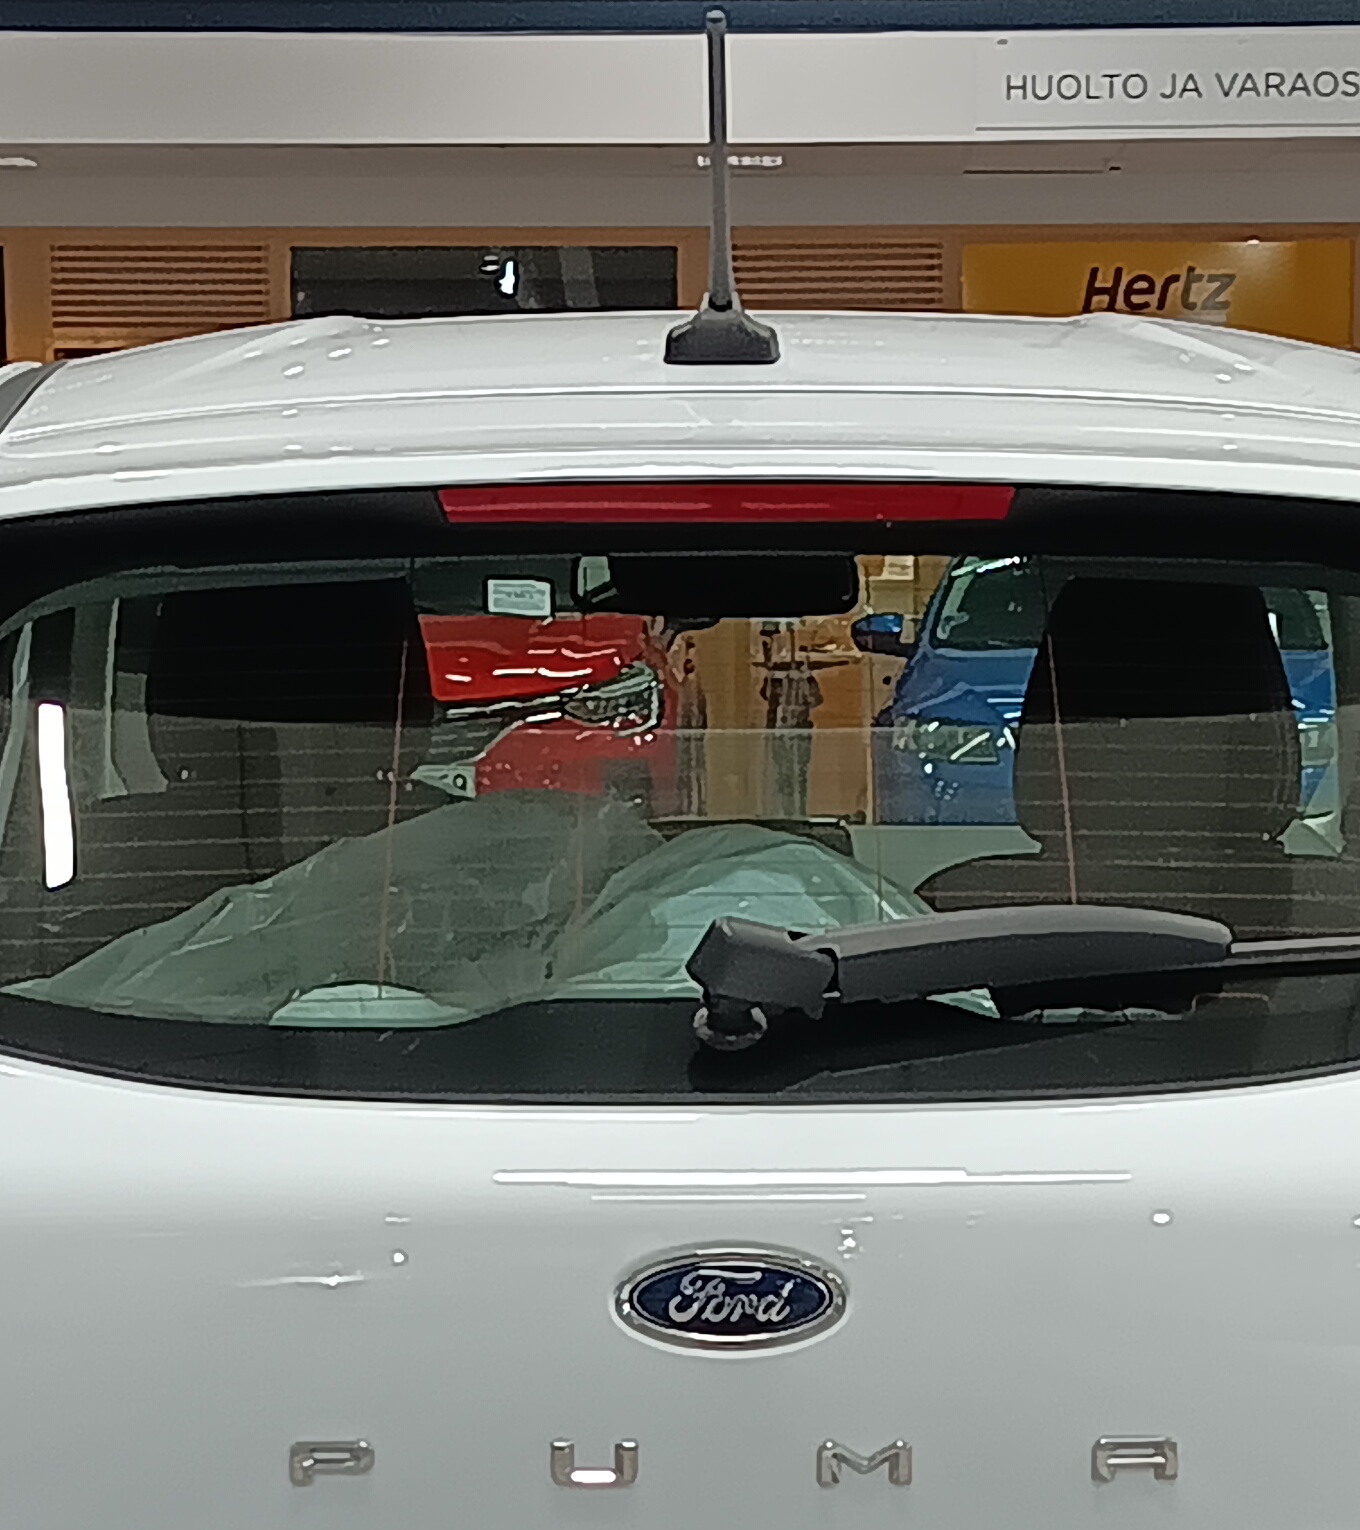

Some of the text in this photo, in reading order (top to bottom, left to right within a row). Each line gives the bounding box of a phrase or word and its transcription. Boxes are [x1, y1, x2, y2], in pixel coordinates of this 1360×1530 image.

[1005, 73, 1148, 100] HUOLTO
[1159, 73, 1204, 99] JA
[1082, 265, 1237, 313] Hertz
[668, 1269, 801, 1323] Ford
[289, 1436, 1178, 1487] PUMA
